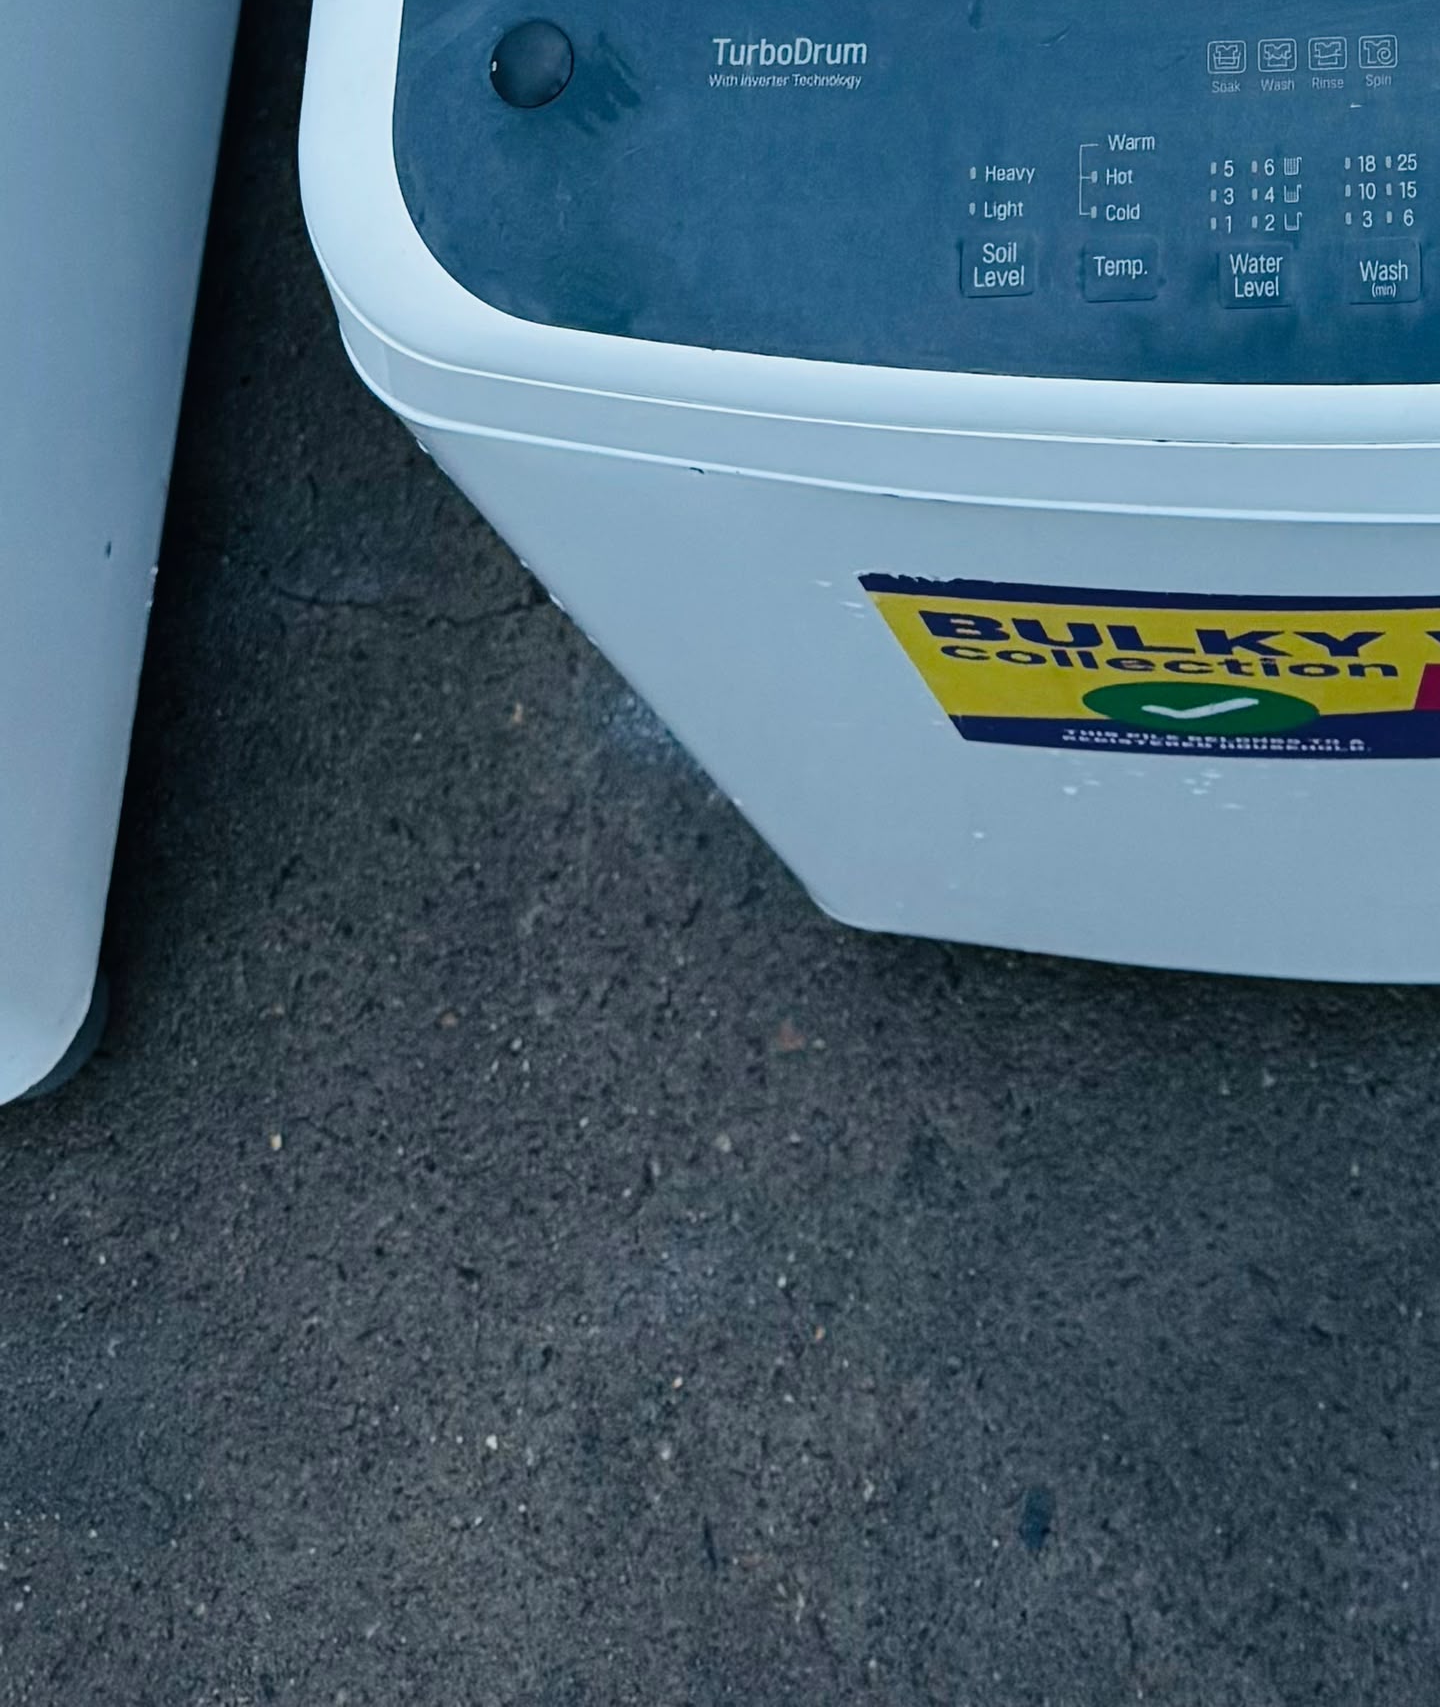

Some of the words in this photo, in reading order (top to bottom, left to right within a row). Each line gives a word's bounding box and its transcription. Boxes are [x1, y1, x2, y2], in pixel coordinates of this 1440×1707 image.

[712, 37, 868, 66] TurboDrum
[792, 73, 862, 89] Technology
[1211, 80, 1241, 93] Soak
[1260, 78, 1295, 92] Wash
[1312, 77, 1344, 90] Rinse
[1365, 74, 1392, 88] Spin
[1108, 134, 1155, 151] Warm
[1223, 160, 1234, 178] 5
[1264, 159, 1275, 176] 6
[1358, 155, 1376, 173] 18
[1397, 154, 1417, 171] 25
[985, 166, 1035, 183] Heavy
[1106, 168, 1133, 185] Hot
[1224, 188, 1234, 205] 3
[1264, 186, 1275, 203] 4
[1358, 183, 1376, 200] 10
[1400, 181, 1417, 198] 15
[984, 201, 1024, 220] Light
[1106, 203, 1140, 221] Cold
[1362, 211, 1373, 228] 3
[1403, 209, 1414, 227] 6
[1225, 216, 1232, 233] 1
[1264, 214, 1275, 231] 2
[982, 242, 1017, 263] Soil
[1093, 256, 1148, 279] Temp.
[1229, 253, 1283, 275] Water
[1359, 259, 1408, 282] Wash
[973, 265, 1025, 287] Level
[1234, 276, 1279, 298] Level
[1371, 282, 1396, 298] (min)
[918, 610, 1386, 657] BULKY
[940, 644, 1398, 677] collection
